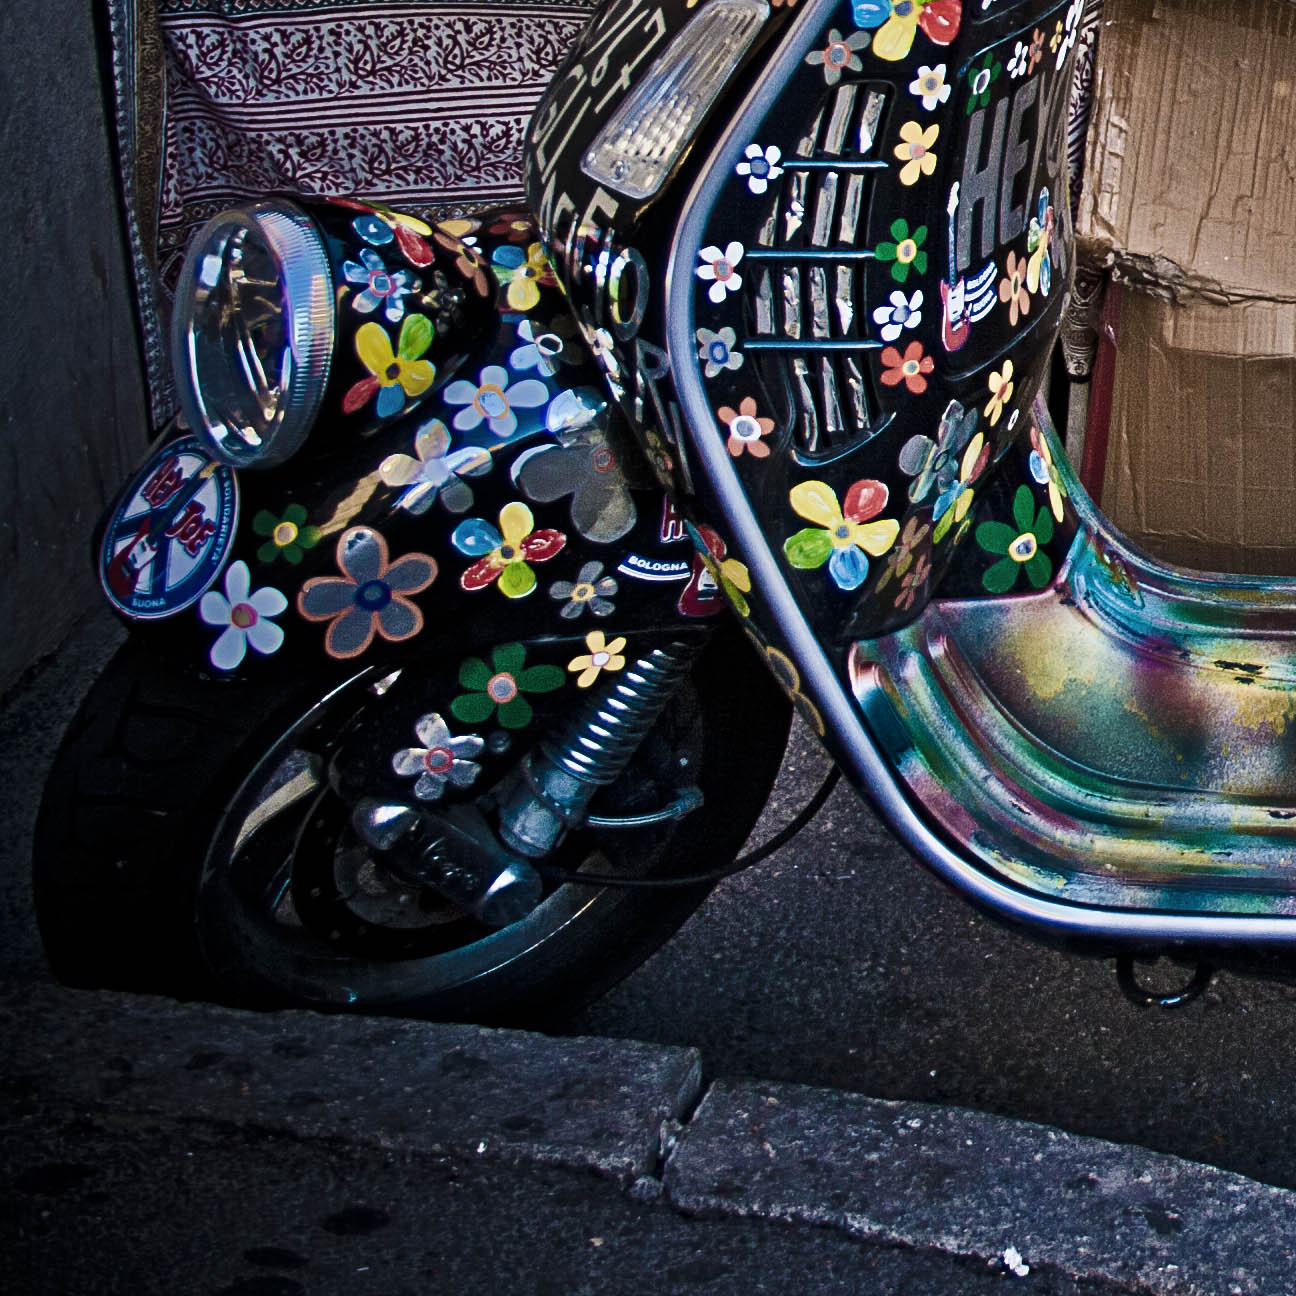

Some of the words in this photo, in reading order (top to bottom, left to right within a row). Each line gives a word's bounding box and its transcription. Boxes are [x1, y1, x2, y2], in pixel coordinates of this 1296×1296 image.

[165, 500, 217, 558] JOE
[627, 554, 689, 572] BOLOGNA
[131, 597, 167, 608] SUONA
